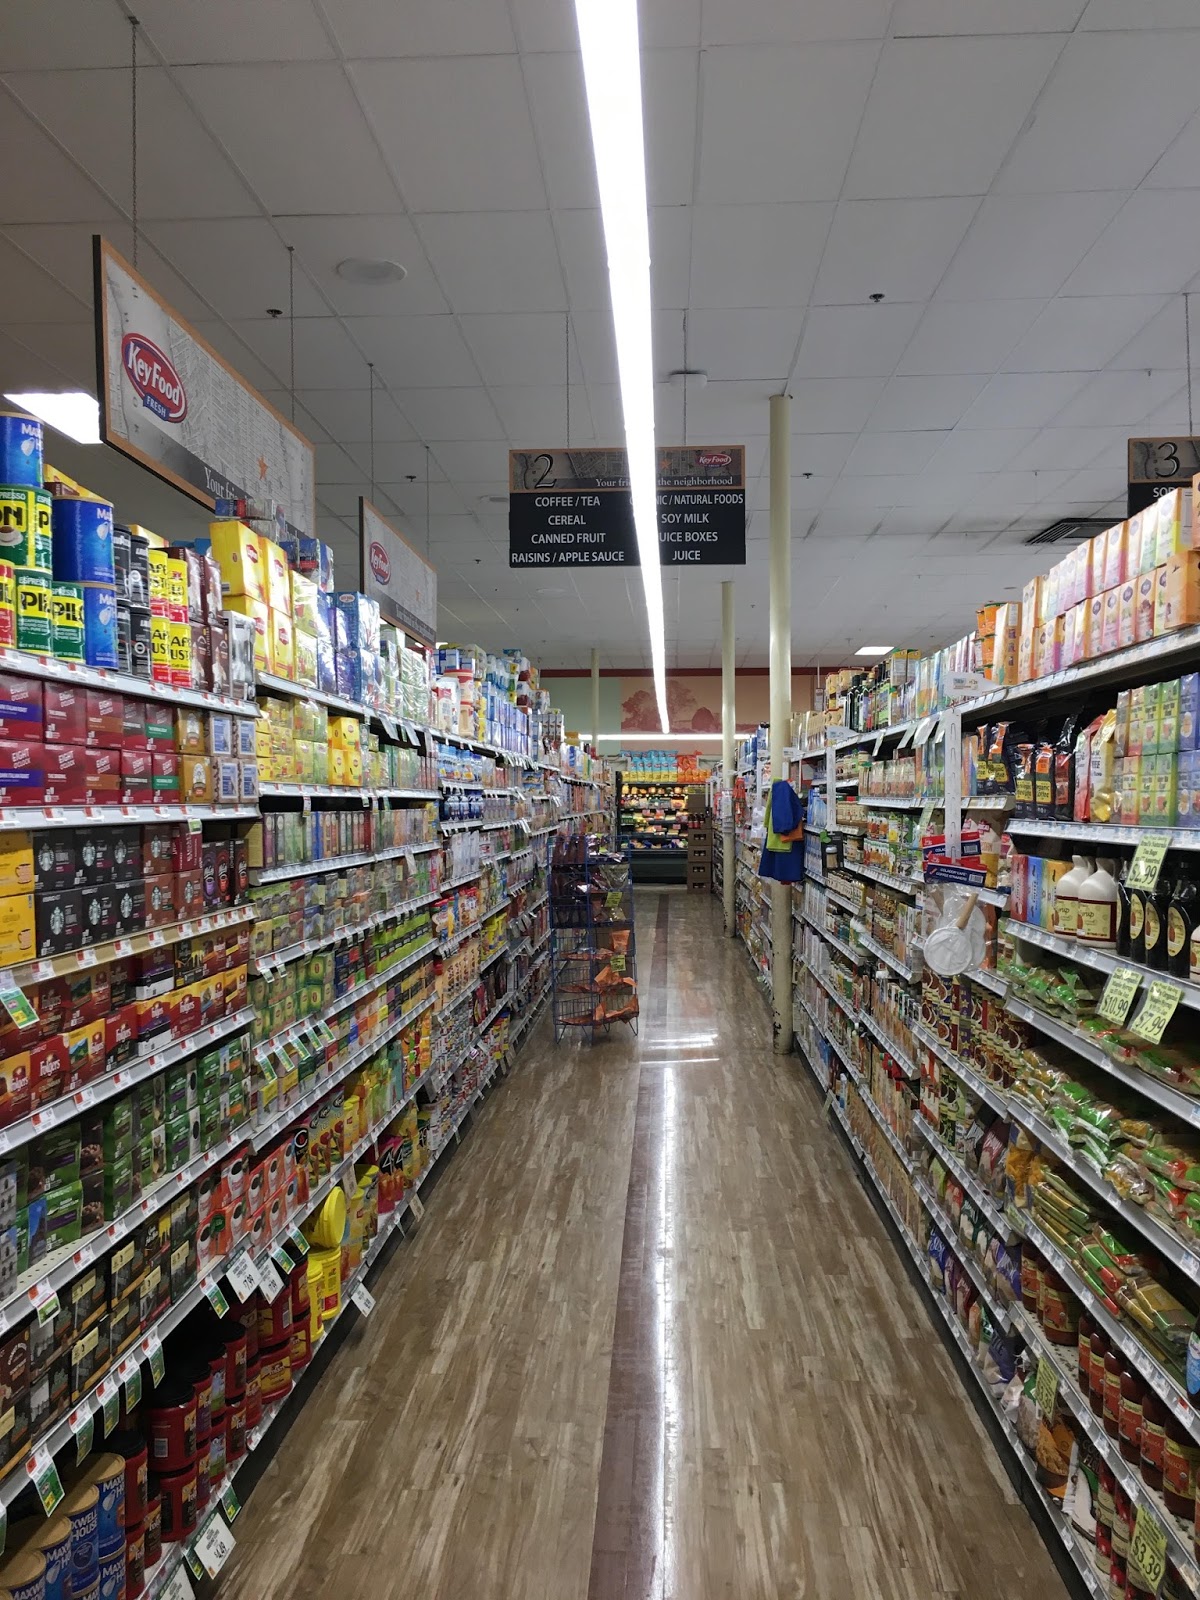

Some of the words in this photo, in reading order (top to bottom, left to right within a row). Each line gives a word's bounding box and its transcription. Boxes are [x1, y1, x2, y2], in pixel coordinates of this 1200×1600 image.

[128, 341, 180, 406] KeyFood
[146, 395, 166, 417] FRESH
[1156, 442, 1180, 477] 3
[534, 454, 557, 489] 2
[204, 466, 224, 499] Your
[596, 478, 616, 487] Your
[619, 477, 631, 487] fri
[658, 477, 671, 486] the
[674, 476, 733, 487] neighborhood
[535, 497, 573, 507] COFFEE
[575, 497, 579, 507] /
[581, 496, 600, 506] TEA
[674, 494, 712, 505] NATURAL
[714, 493, 744, 504] FOODS
[548, 515, 586, 526] CEREAL
[661, 513, 681, 524] SOY
[684, 513, 709, 523] MILK
[531, 534, 574, 544] CANNED
[577, 533, 606, 543] FRUIT
[659, 532, 682, 543] UICE
[685, 532, 718, 542] BOXES
[512, 552, 550, 563] RAISINS
[552, 552, 556, 562] /
[559, 552, 590, 562] APPLE
[592, 551, 624, 562] SAUCE
[672, 551, 700, 560] JUICE
[11, 747, 29, 762] EIGHT
[58, 750, 74, 763] EIGHT
[180, 999, 195, 1014] Folgers
[1102, 995, 1129, 1018] $10.99
[1135, 1011, 1167, 1036] $7.99
[116, 1027, 132, 1043] Folgers
[40, 1059, 60, 1078] Folgers
[11, 1077, 29, 1091] Folgers
[71, 1509, 97, 1530] XWELL
[1132, 1535, 1162, 1582] $3.39
